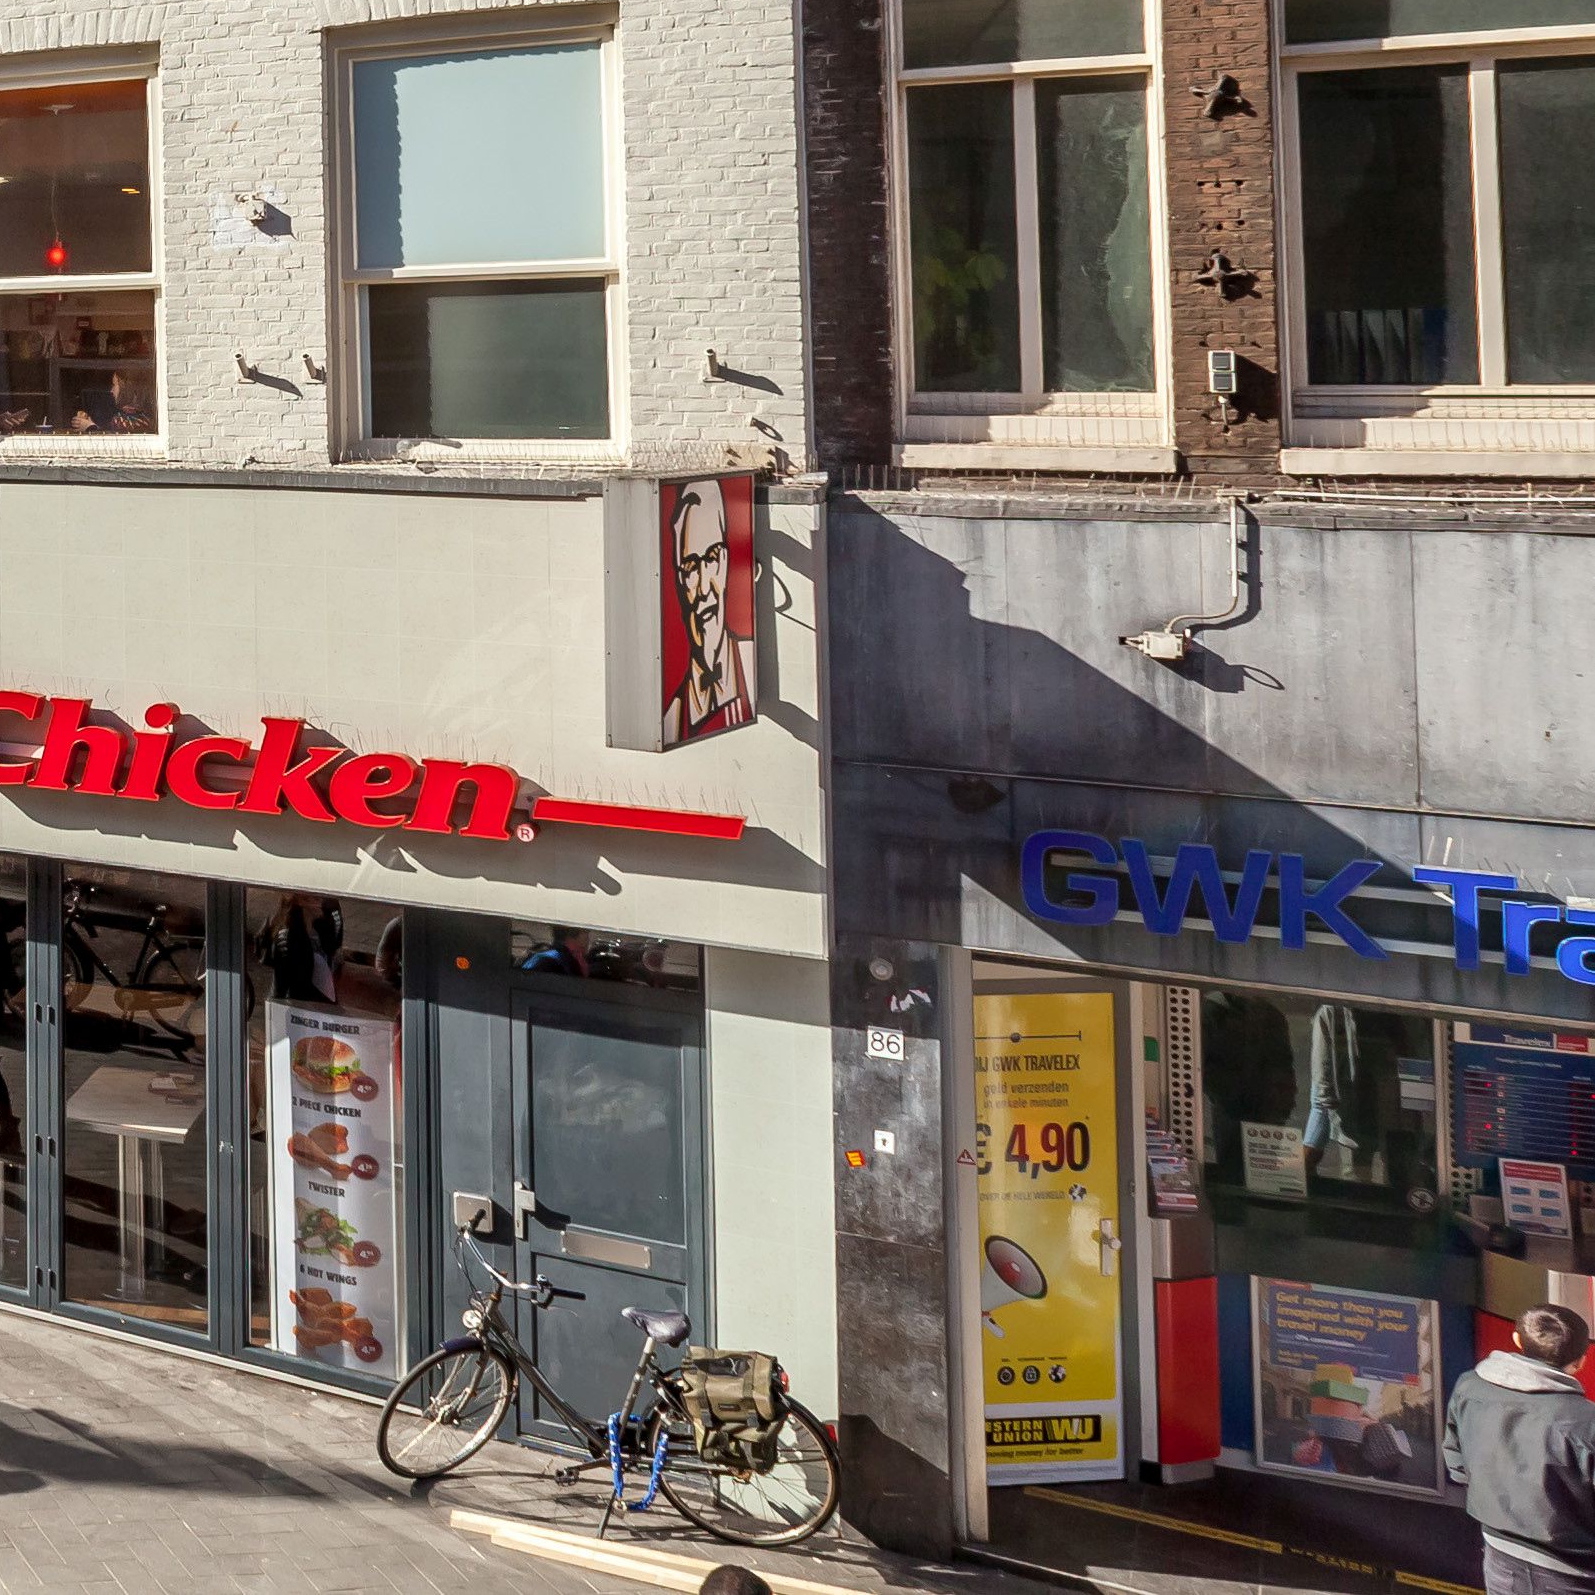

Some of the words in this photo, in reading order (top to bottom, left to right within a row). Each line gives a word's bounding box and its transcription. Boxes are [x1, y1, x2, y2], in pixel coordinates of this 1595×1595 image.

[1019, 828, 1389, 961] GWK
[290, 1014, 319, 1030] ZINGER
[322, 1021, 360, 1035] BURGER
[871, 1031, 901, 1054] 86
[992, 1055, 1021, 1072] GWK
[1023, 1053, 1081, 1071] TRAVELEX
[983, 1081, 1008, 1098] geld
[1011, 1080, 1069, 1094] verzenden
[299, 1097, 321, 1112] PIECE
[324, 1104, 361, 1118] CHICKEN
[1005, 1121, 1091, 1180] 4,90
[308, 1180, 346, 1198] TWISTER
[307, 1266, 323, 1279] HOT
[326, 1271, 358, 1286] WINGS
[1276, 1291, 1300, 1304] Get
[1304, 1297, 1339, 1309] more
[1343, 1301, 1375, 1314] than
[1378, 1308, 1403, 1319] you
[1277, 1305, 1341, 1322] imagined
[1344, 1315, 1375, 1327] with
[1377, 1320, 1410, 1333] your
[1277, 1318, 1316, 1331] travel
[1319, 1325, 1368, 1342] money
[993, 1430, 1044, 1444] UNION
